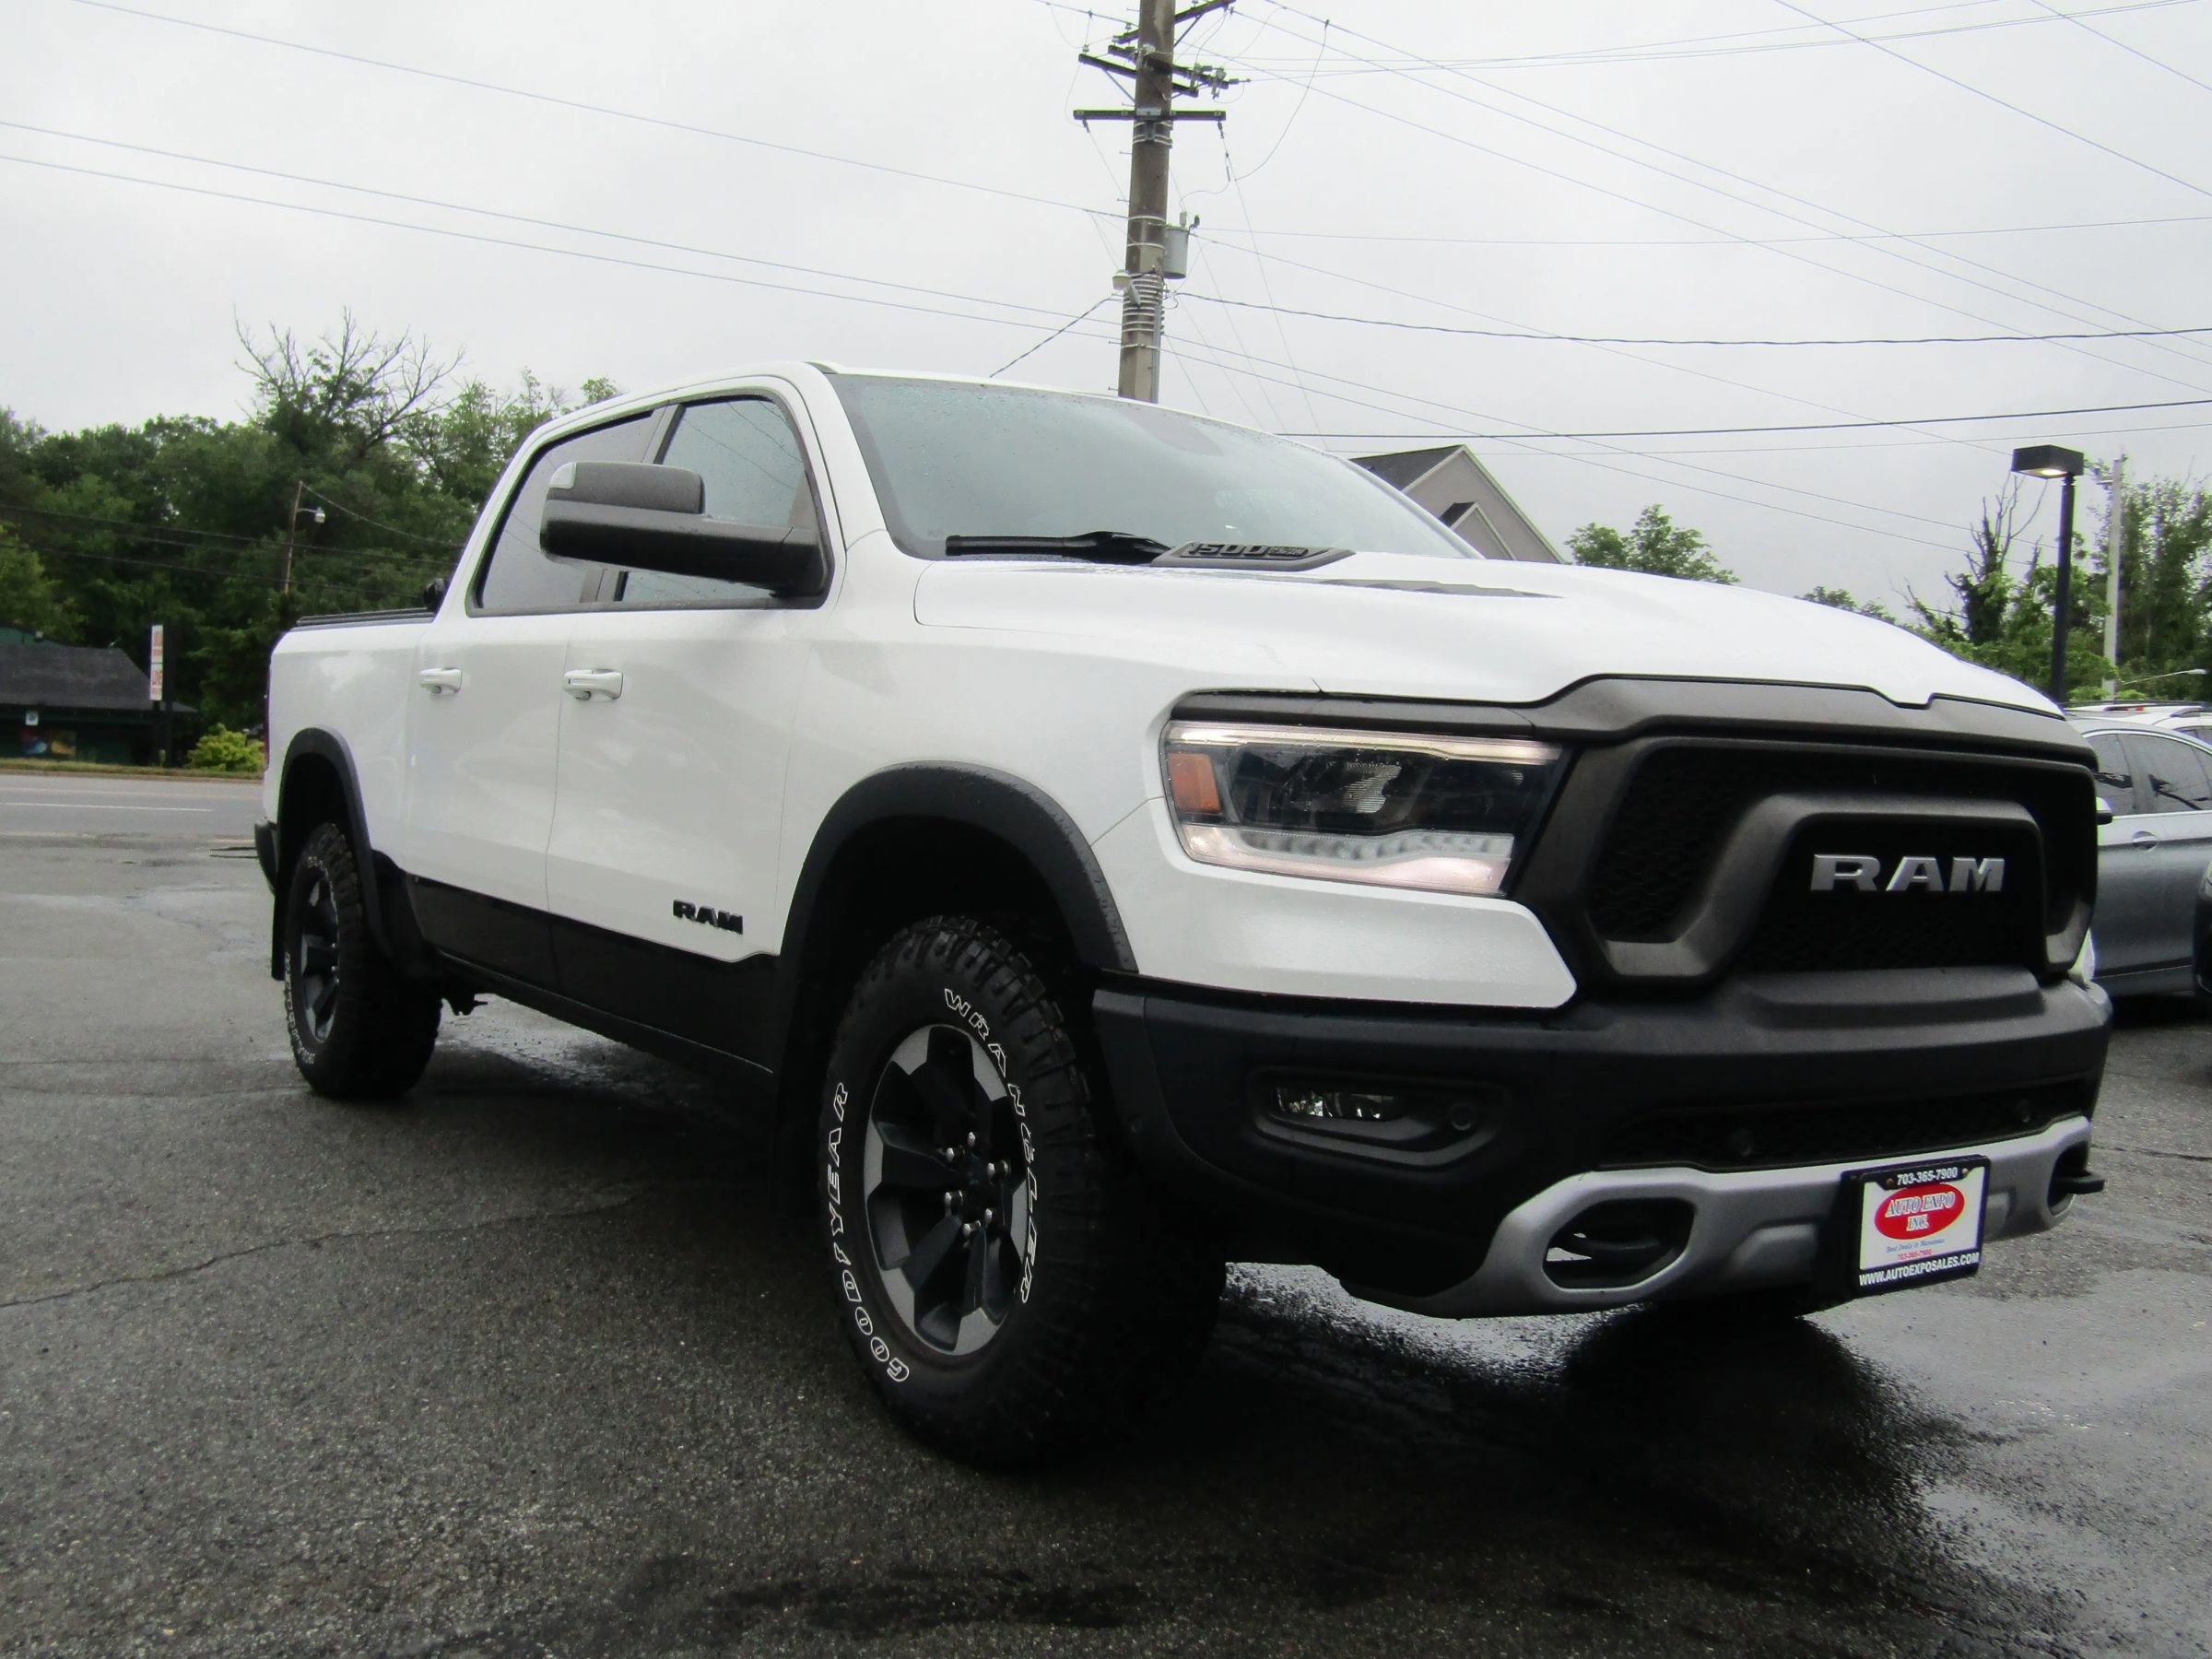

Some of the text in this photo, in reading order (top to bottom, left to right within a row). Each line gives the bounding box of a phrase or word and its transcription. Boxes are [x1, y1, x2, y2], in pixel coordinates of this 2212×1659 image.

[1186, 543, 1268, 557] 1500
[1811, 854, 2005, 891] RAM
[672, 900, 743, 935] RAM
[945, 988, 1037, 1304] WRANGLER
[1897, 1167, 1958, 1185] 703-365-7900
[1885, 1191, 1955, 1218] AUTO EXPO
[829, 1082, 909, 1382] GOODYEAR
[1859, 1253, 1980, 1286] WWW.AUTOEXPOSALES.COM
